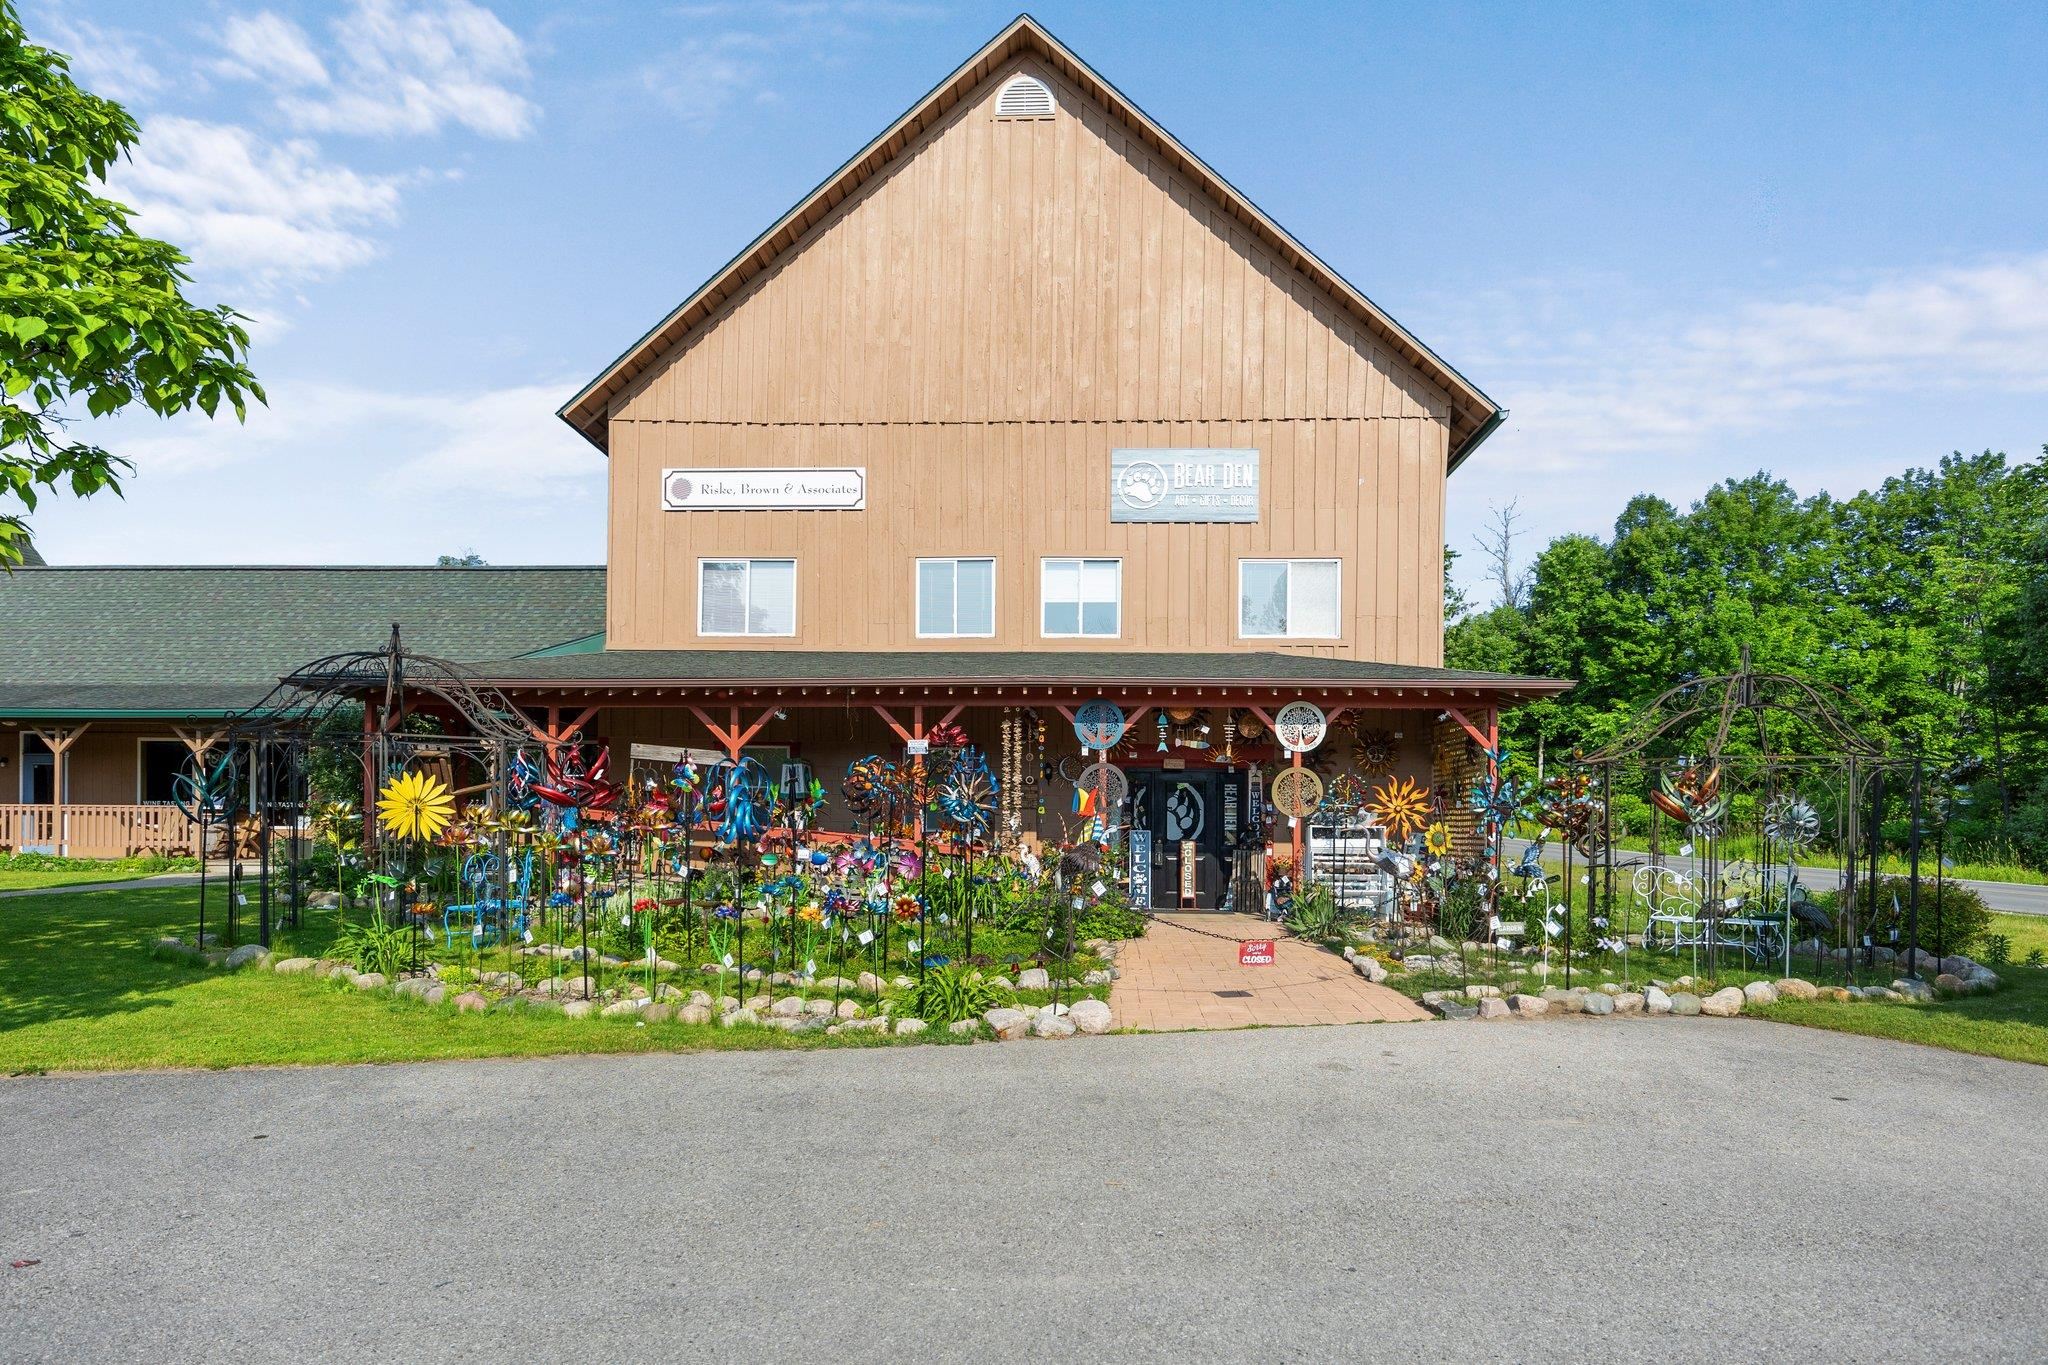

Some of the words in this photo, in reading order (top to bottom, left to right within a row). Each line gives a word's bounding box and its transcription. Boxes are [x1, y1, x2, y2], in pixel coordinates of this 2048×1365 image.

[1174, 463, 1215, 489] BEAR
[1223, 463, 1253, 489] DEN
[701, 483, 735, 495] Riske,
[741, 483, 779, 494] Brown
[784, 483, 794, 495] &
[797, 483, 858, 495] Associates
[1184, 849, 1192, 897] CLOSED
[1242, 955, 1272, 964] CLOSED
